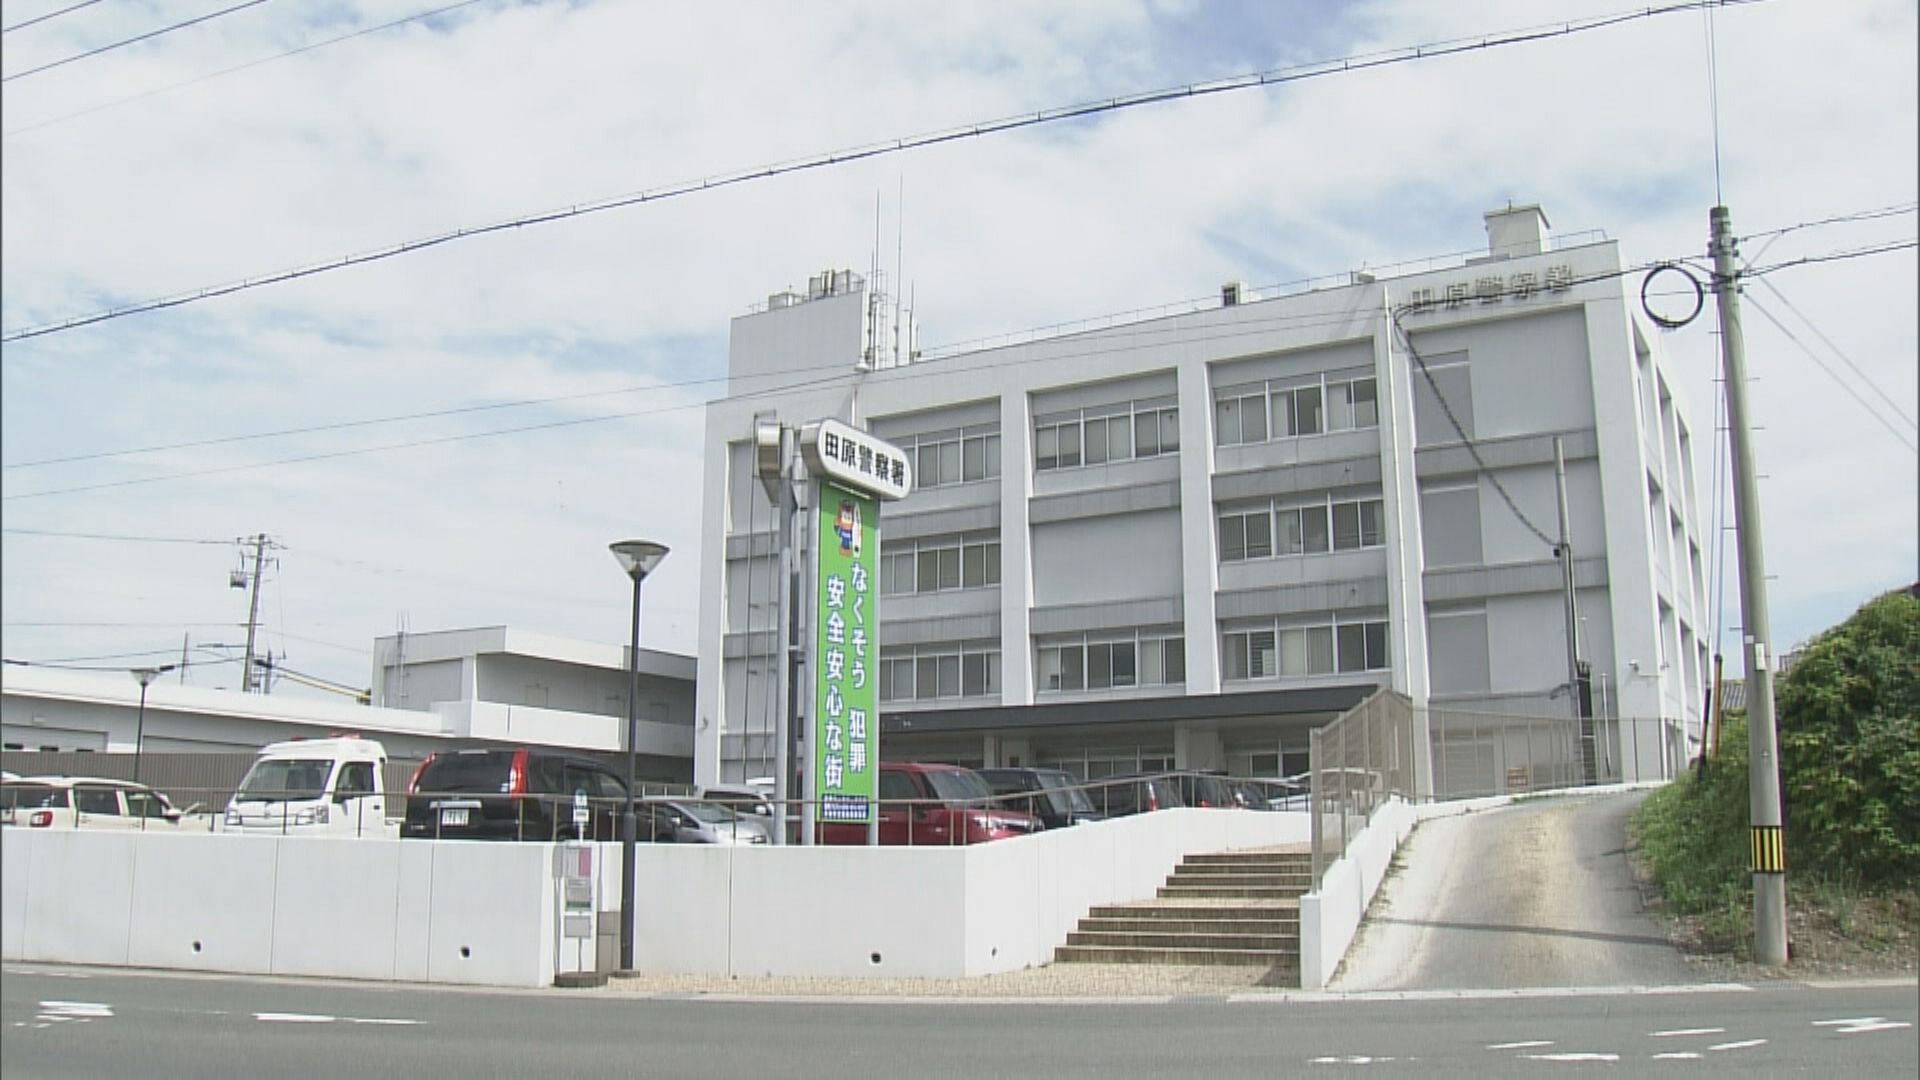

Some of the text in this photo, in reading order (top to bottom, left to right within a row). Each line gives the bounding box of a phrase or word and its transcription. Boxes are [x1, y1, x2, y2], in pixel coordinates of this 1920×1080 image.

[825, 432, 904, 487] 田原警察署
[825, 575, 845, 789] 安全安心な街
[848, 563, 868, 774] なくそう 犯罪
